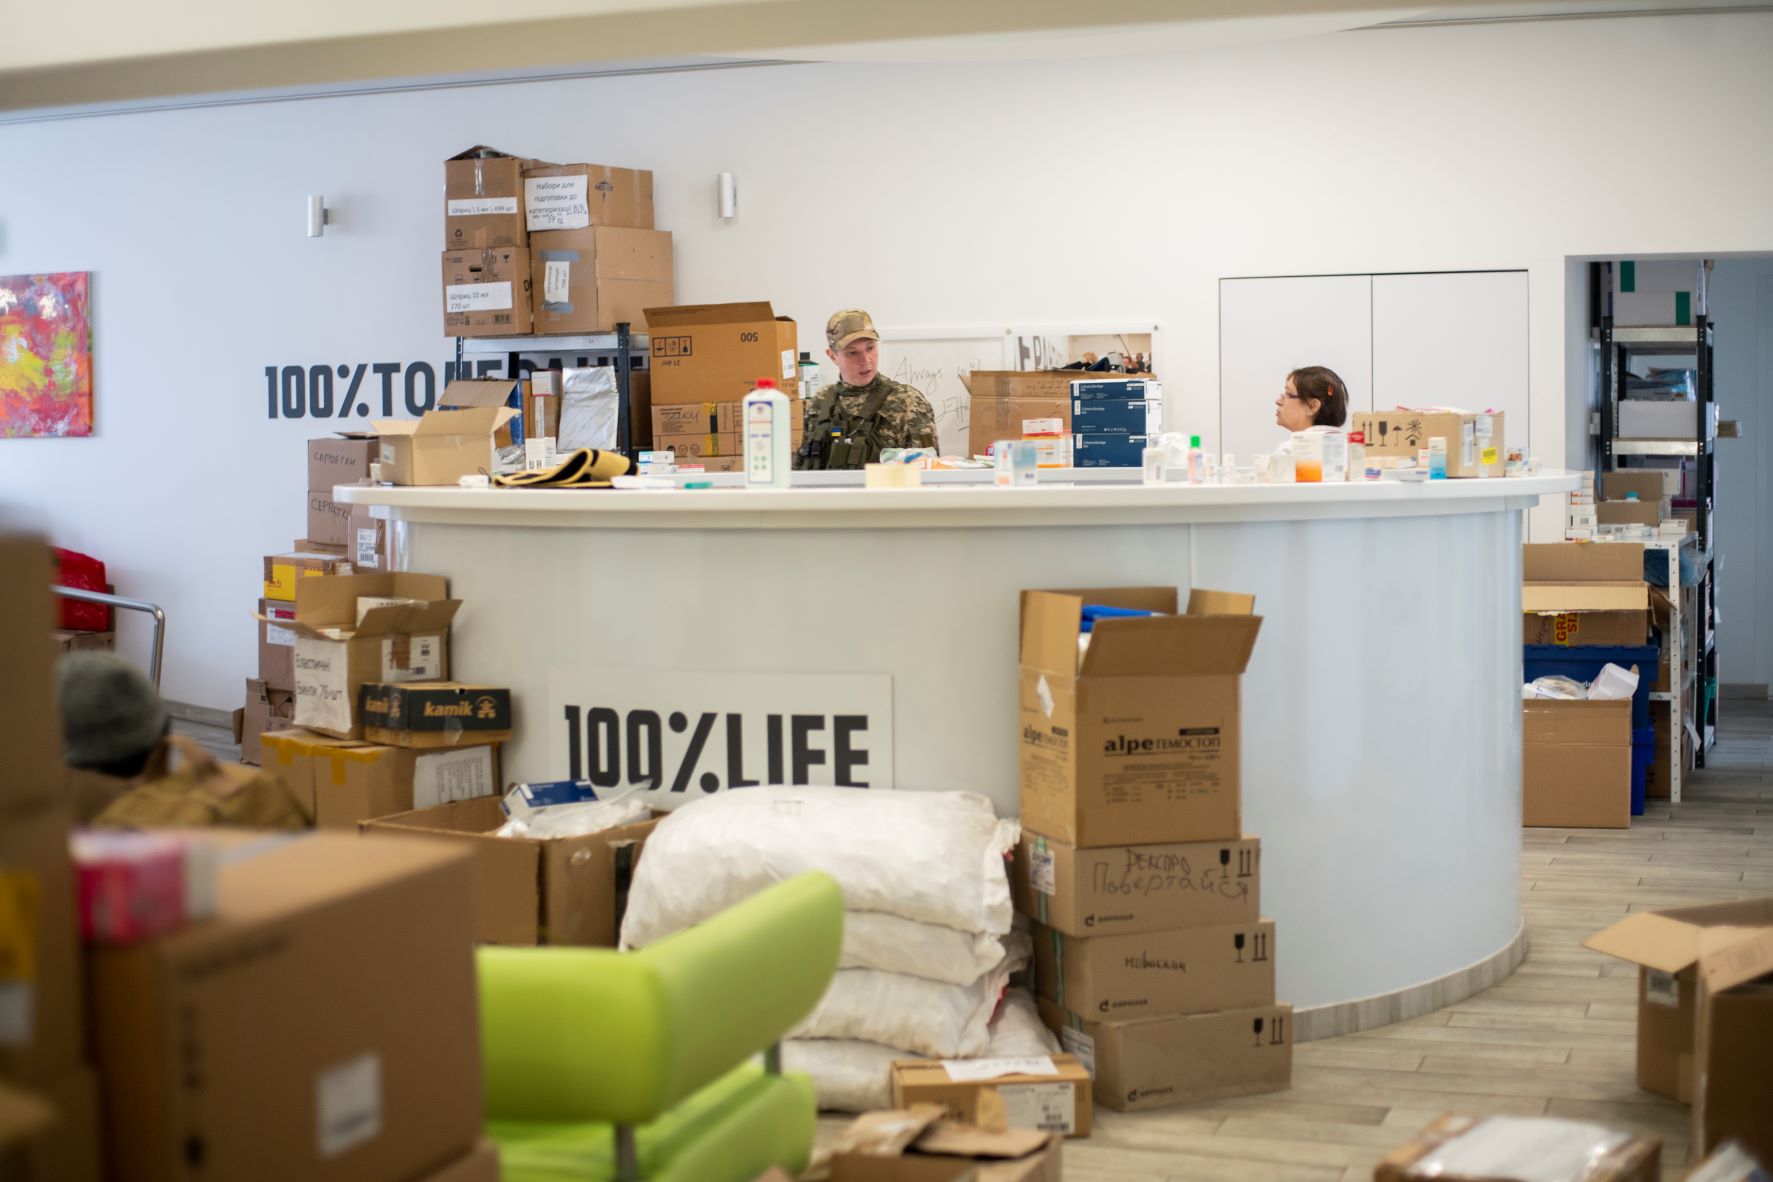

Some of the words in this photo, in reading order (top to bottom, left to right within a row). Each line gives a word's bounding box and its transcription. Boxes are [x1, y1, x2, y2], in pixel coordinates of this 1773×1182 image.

[424, 700, 473, 717] kamik
[564, 704, 870, 794] 100%LIFE
[1105, 735, 1153, 755] alpe
